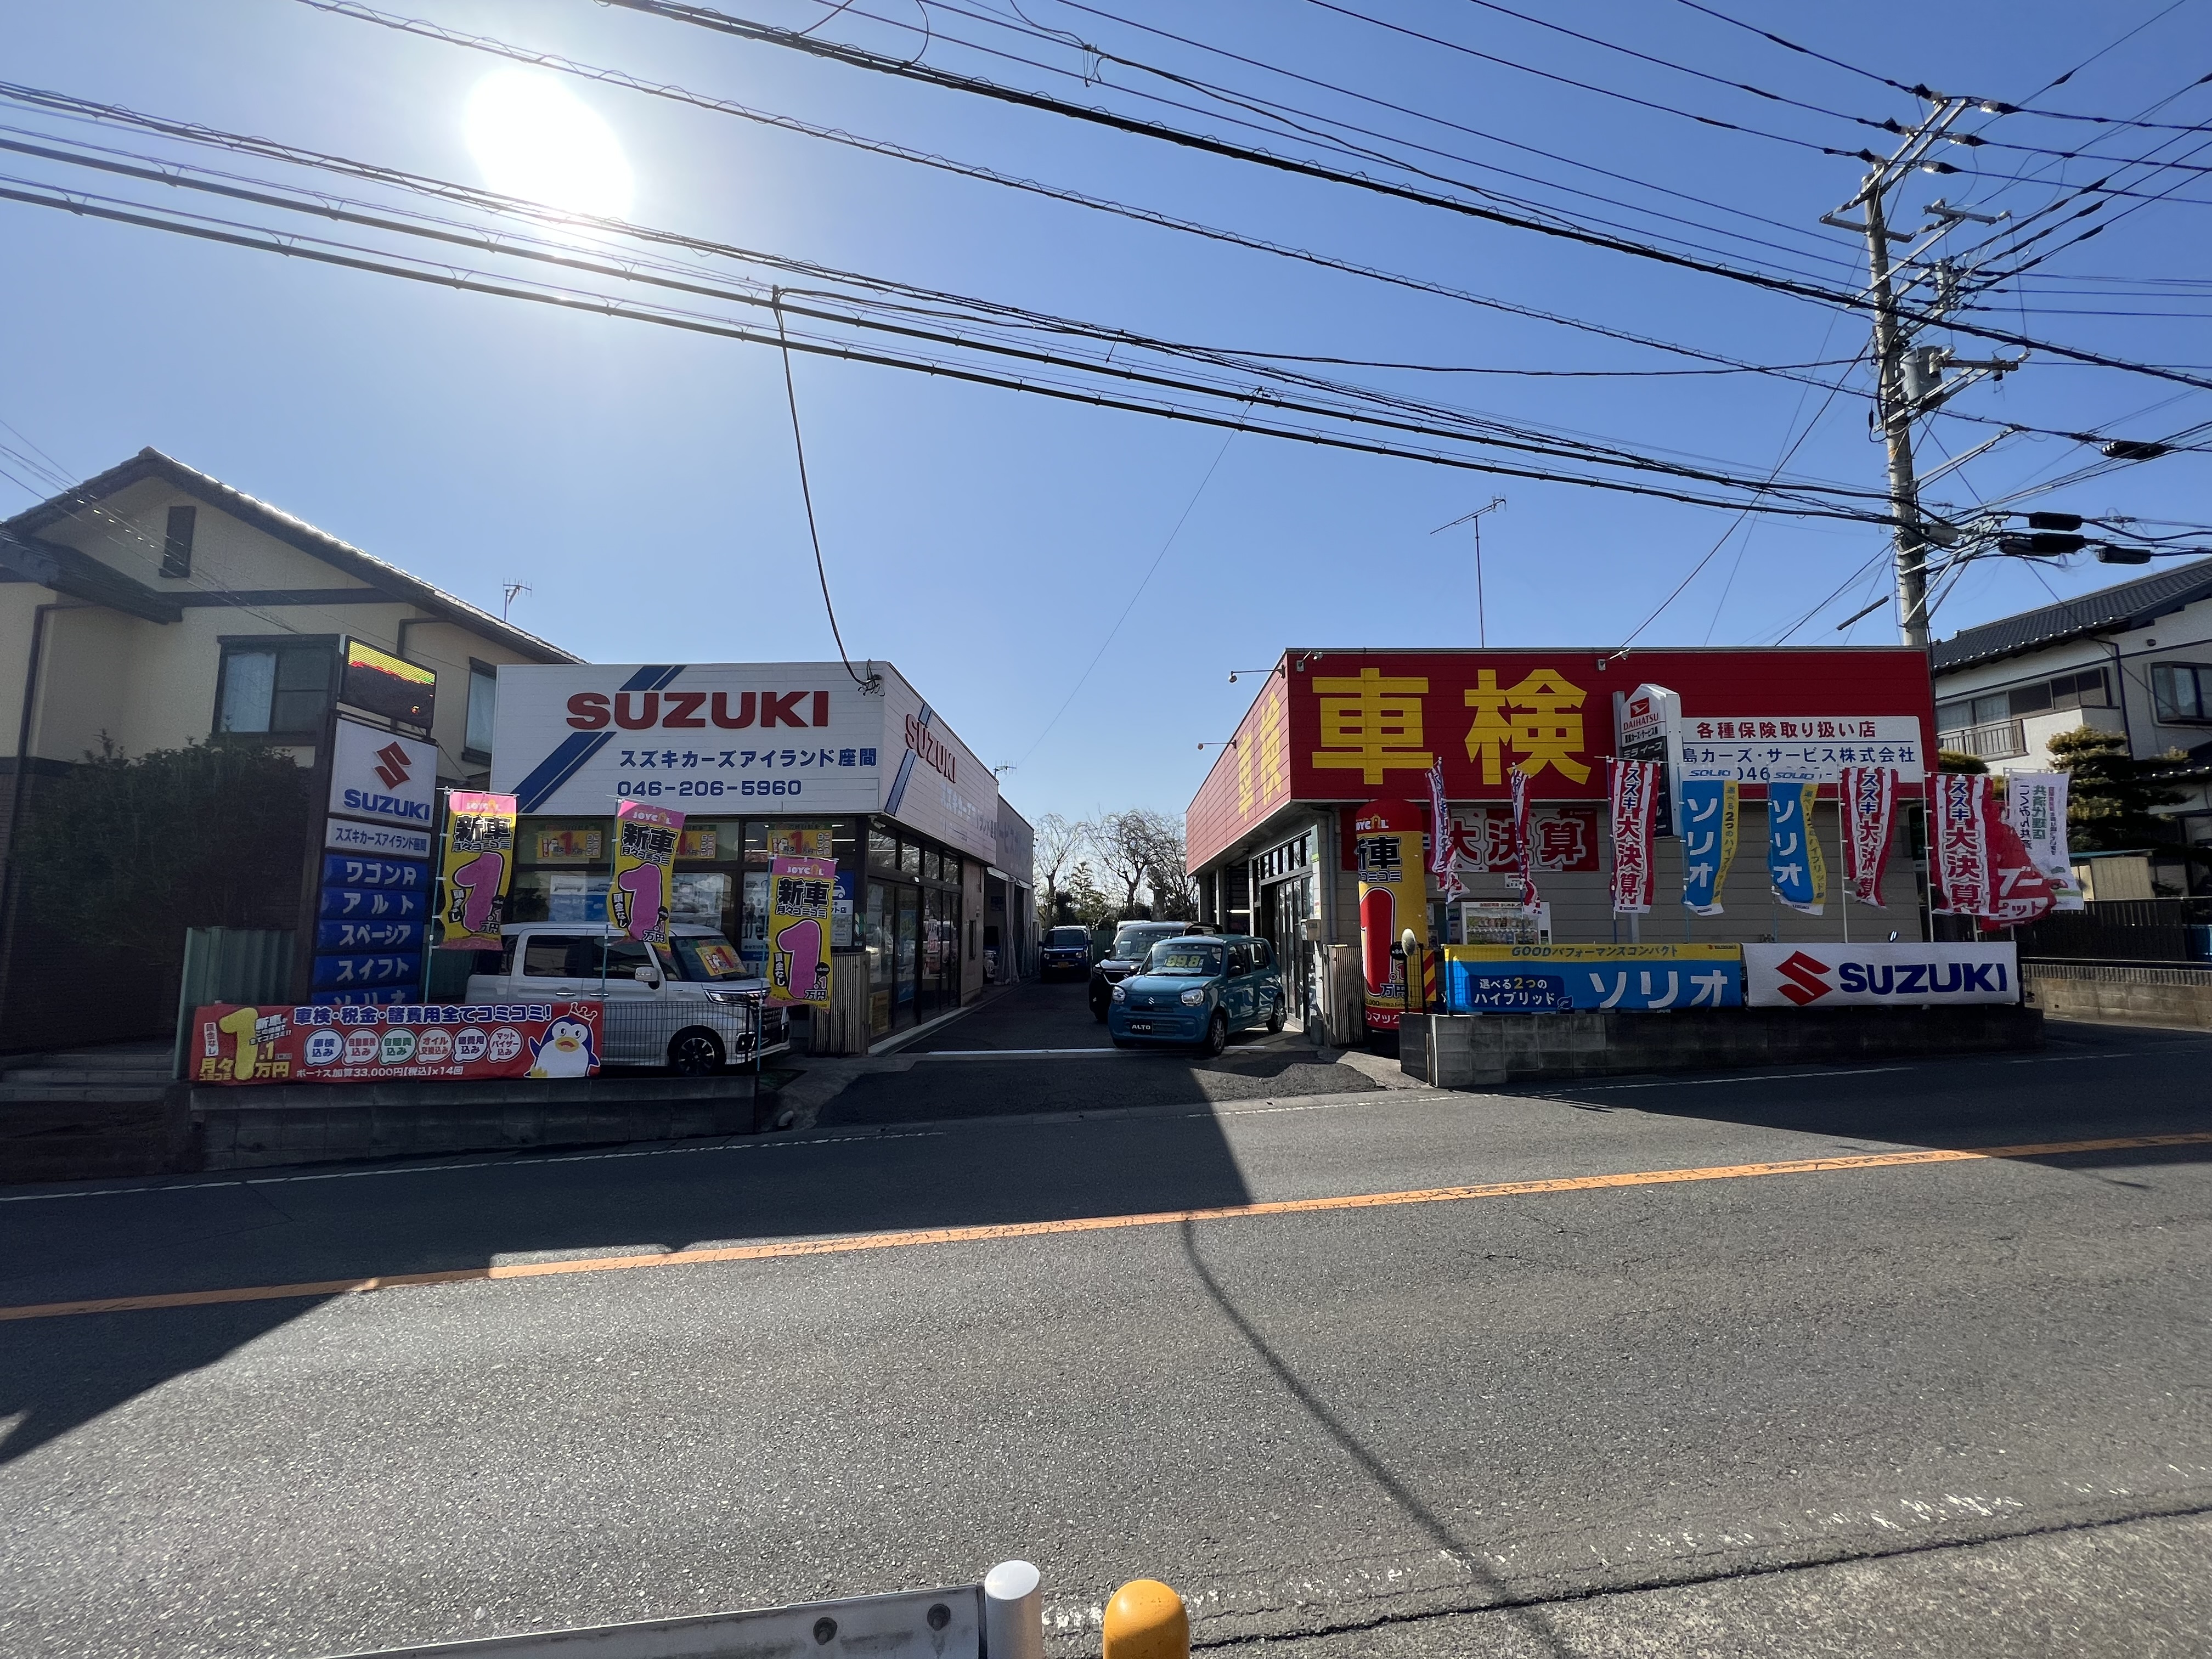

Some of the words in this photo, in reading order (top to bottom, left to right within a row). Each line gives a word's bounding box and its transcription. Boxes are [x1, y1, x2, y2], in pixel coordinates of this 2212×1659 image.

[566, 691, 829, 730] SUZUKI
[1623, 713, 1658, 730] DAIHATSU
[1312, 668, 1591, 785] 車検
[1697, 721, 1876, 738] 各種保険取り扱い店
[620, 748, 877, 768] スズキカーズアイランド座間
[905, 714, 956, 784] SUZUKI
[1238, 690, 1282, 822] 車検
[618, 780, 802, 797] 046-206-5960
[1622, 768, 1639, 810] スズキ
[1860, 775, 1877, 814] スズキ
[344, 789, 430, 820] SUZUKI
[1950, 782, 1969, 820] スズキ
[454, 814, 512, 842] 新車
[622, 822, 678, 855] 新車
[1688, 798, 1717, 887] ソリオ
[1772, 800, 1802, 887] ソリオ
[346, 861, 416, 885] ワゴンR
[343, 893, 414, 915] アルト
[777, 878, 830, 907] 新車
[775, 905, 827, 918] 月々コミコミ
[339, 924, 411, 946] スペーシア
[337, 957, 409, 982] スイフト
[1166, 955, 1200, 967] 99.8
[1480, 977, 1547, 989] 選べる2つの
[1589, 969, 1728, 1008] ソリオ
[1838, 962, 2007, 995] SUZUKI
[1474, 992, 1555, 1005] ハイブリッド
[312, 1048, 333, 1058] 込み
[352, 1047, 371, 1057] 込み
[387, 1046, 407, 1056] 込み
[423, 1037, 449, 1045] オイル
[461, 1046, 479, 1054] 込み
